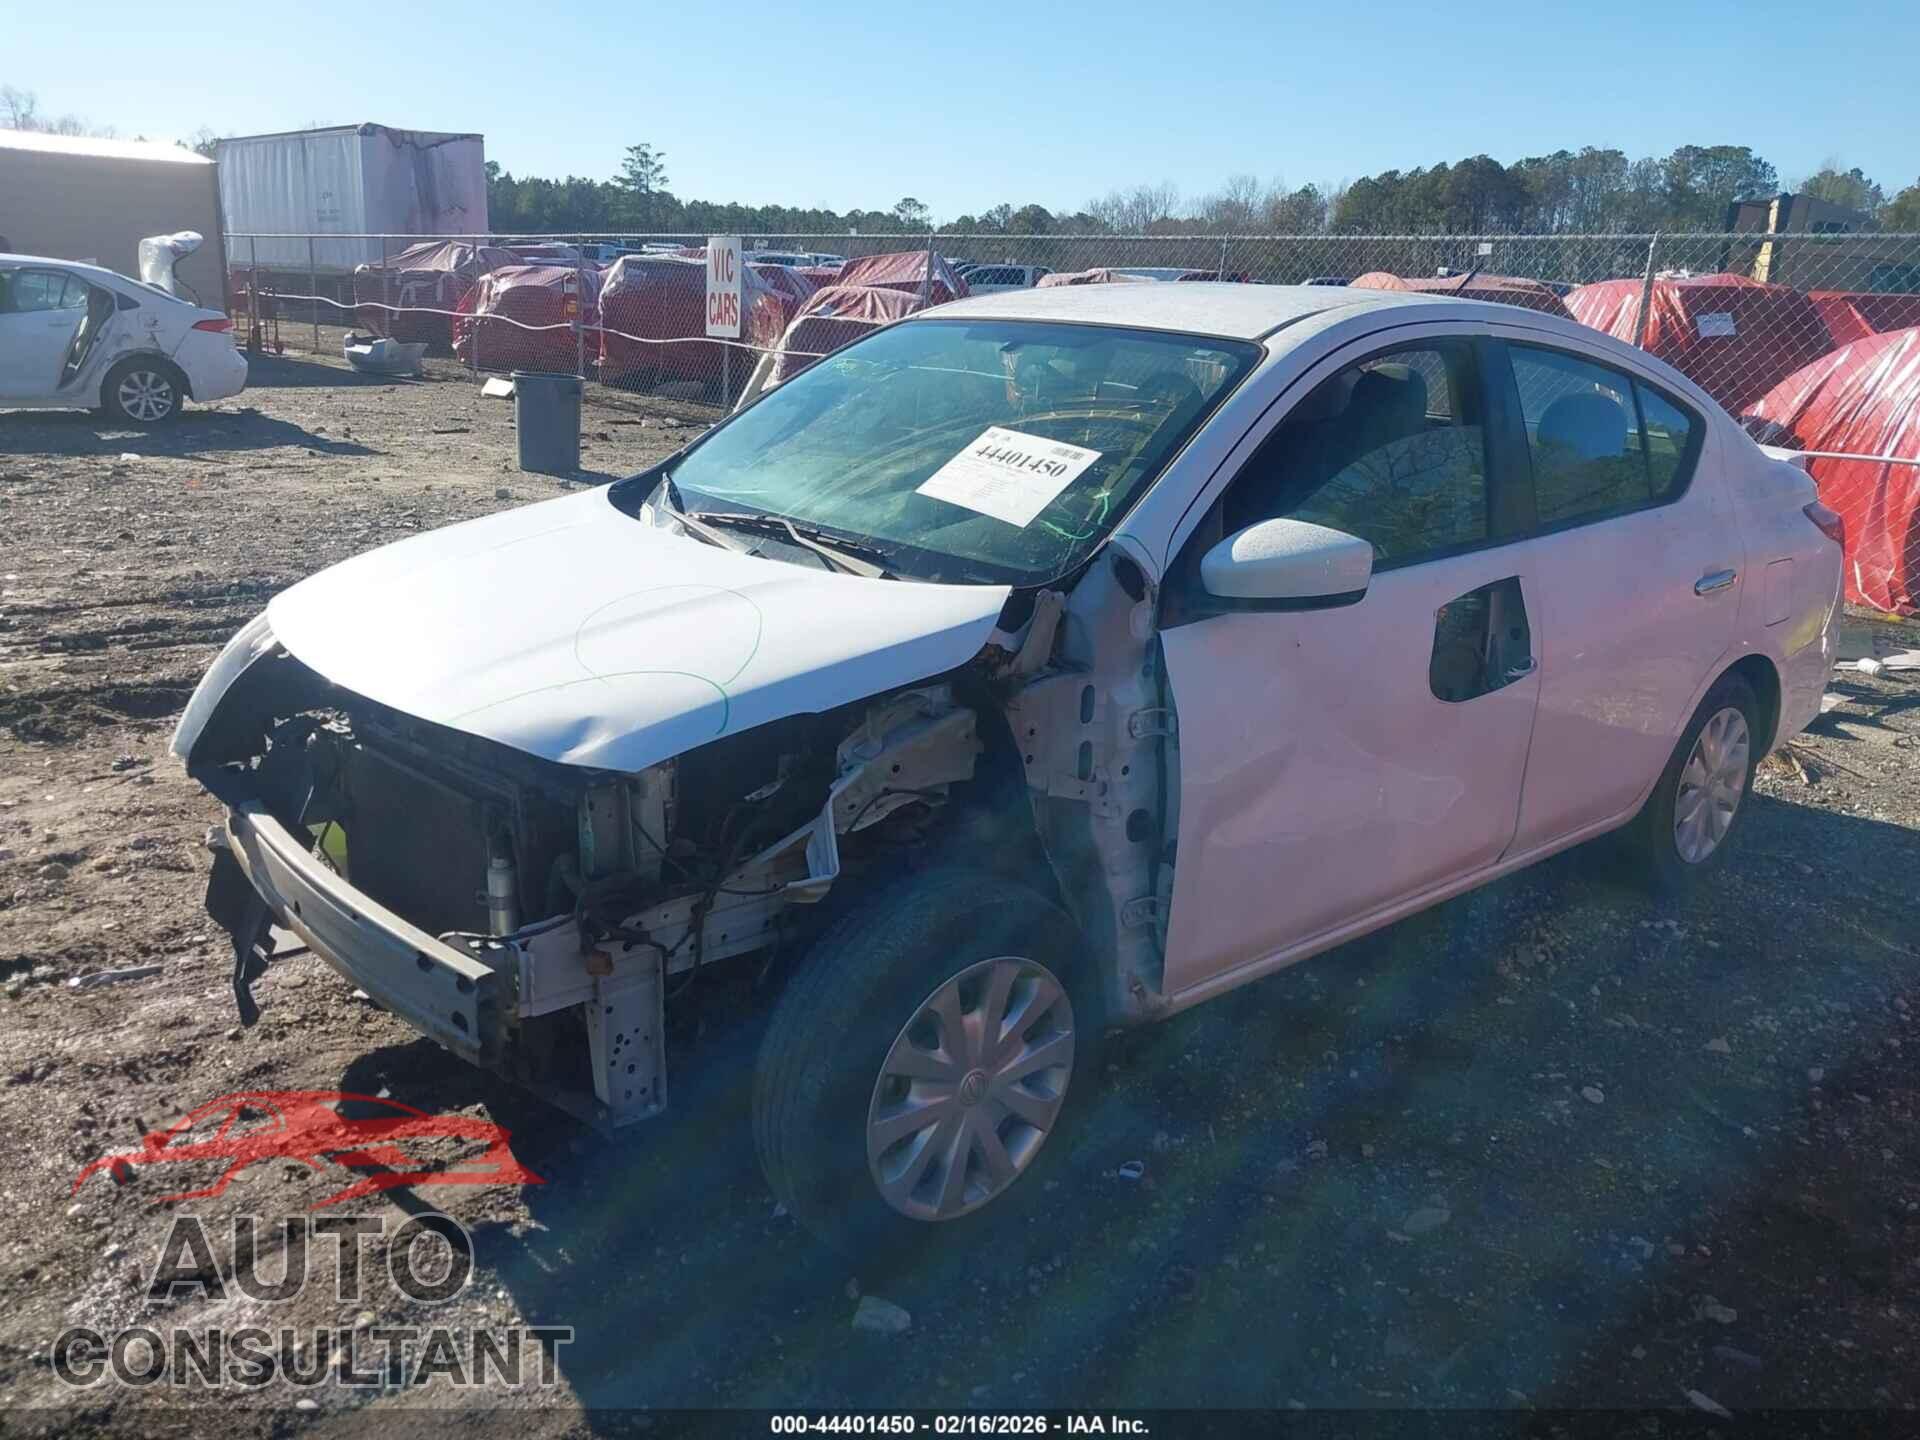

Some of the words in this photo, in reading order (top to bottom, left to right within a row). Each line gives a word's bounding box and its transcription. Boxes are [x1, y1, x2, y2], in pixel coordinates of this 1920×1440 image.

[713, 247, 734, 282] VIC
[709, 291, 738, 328] CARS
[975, 444, 1068, 478] 44401450
